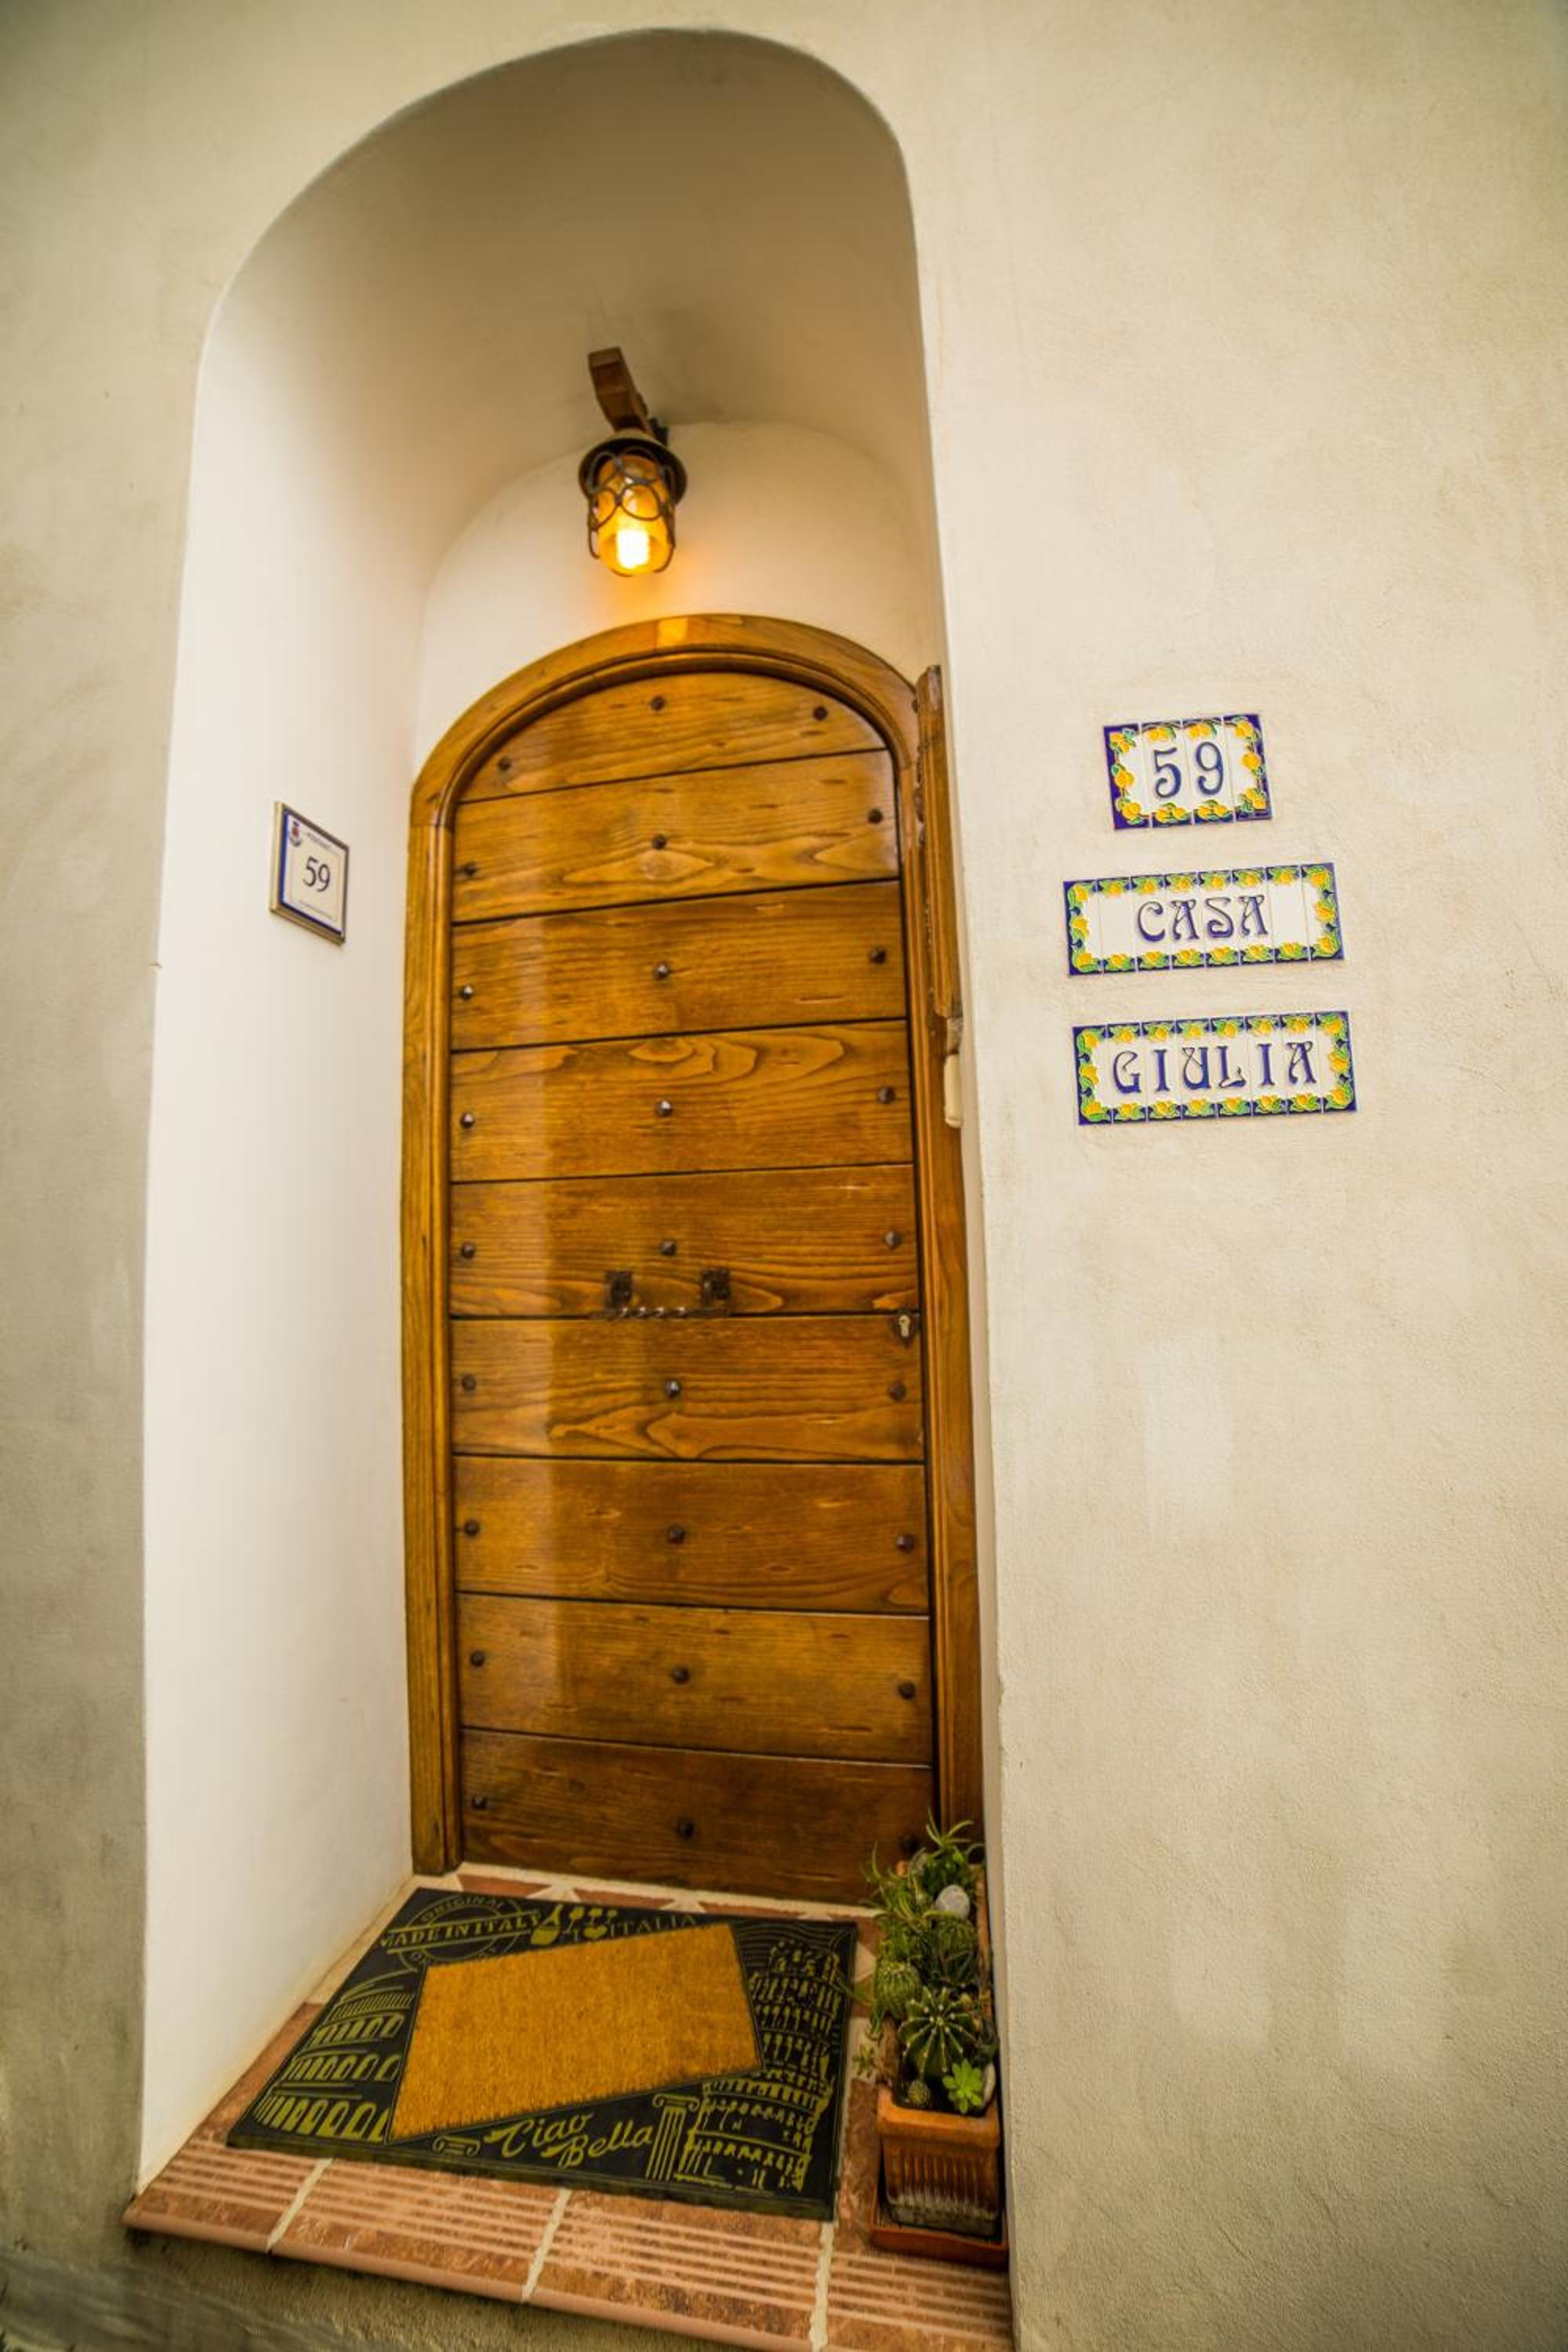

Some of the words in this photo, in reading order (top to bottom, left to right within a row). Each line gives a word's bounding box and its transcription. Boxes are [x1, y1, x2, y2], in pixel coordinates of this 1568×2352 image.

[1152, 740, 1225, 800] 59
[303, 855, 331, 893] 59
[1137, 893, 1269, 942] CASA
[1111, 1040, 1318, 1095] GIULIA
[379, 1926, 439, 1947] MADE
[445, 1922, 469, 1939] IN
[474, 1913, 541, 1936] ITALY
[609, 1915, 698, 1938] ITALIA
[483, 2113, 593, 2158] Ciao
[540, 2118, 654, 2170] Bella
